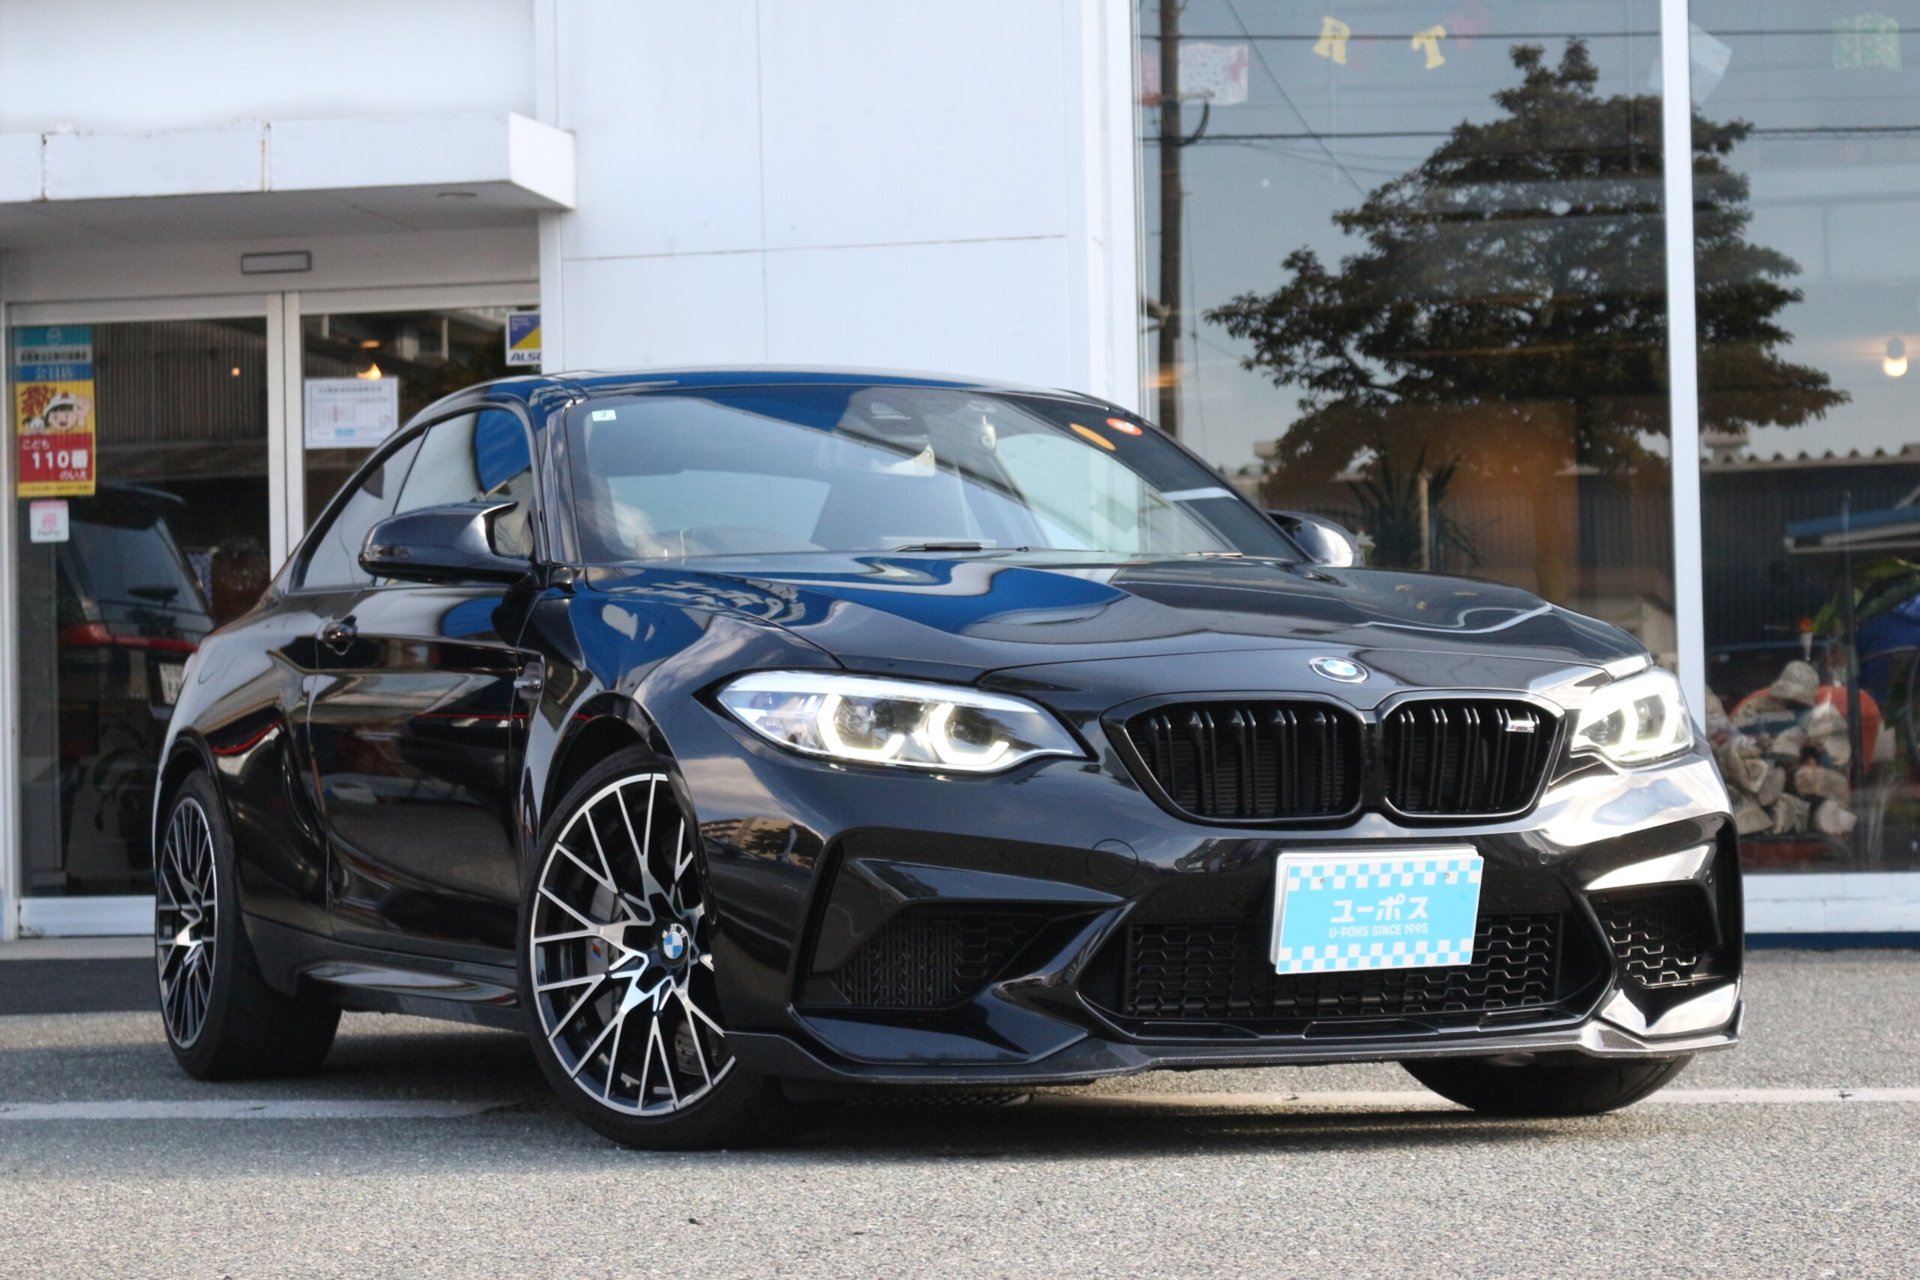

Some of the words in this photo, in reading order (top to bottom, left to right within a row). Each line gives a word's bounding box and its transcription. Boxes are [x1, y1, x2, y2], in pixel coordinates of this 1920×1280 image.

[1330, 893, 1429, 923] ユーポス
[1371, 924, 1402, 937] SINCE
[1404, 922, 1429, 935] 1995
